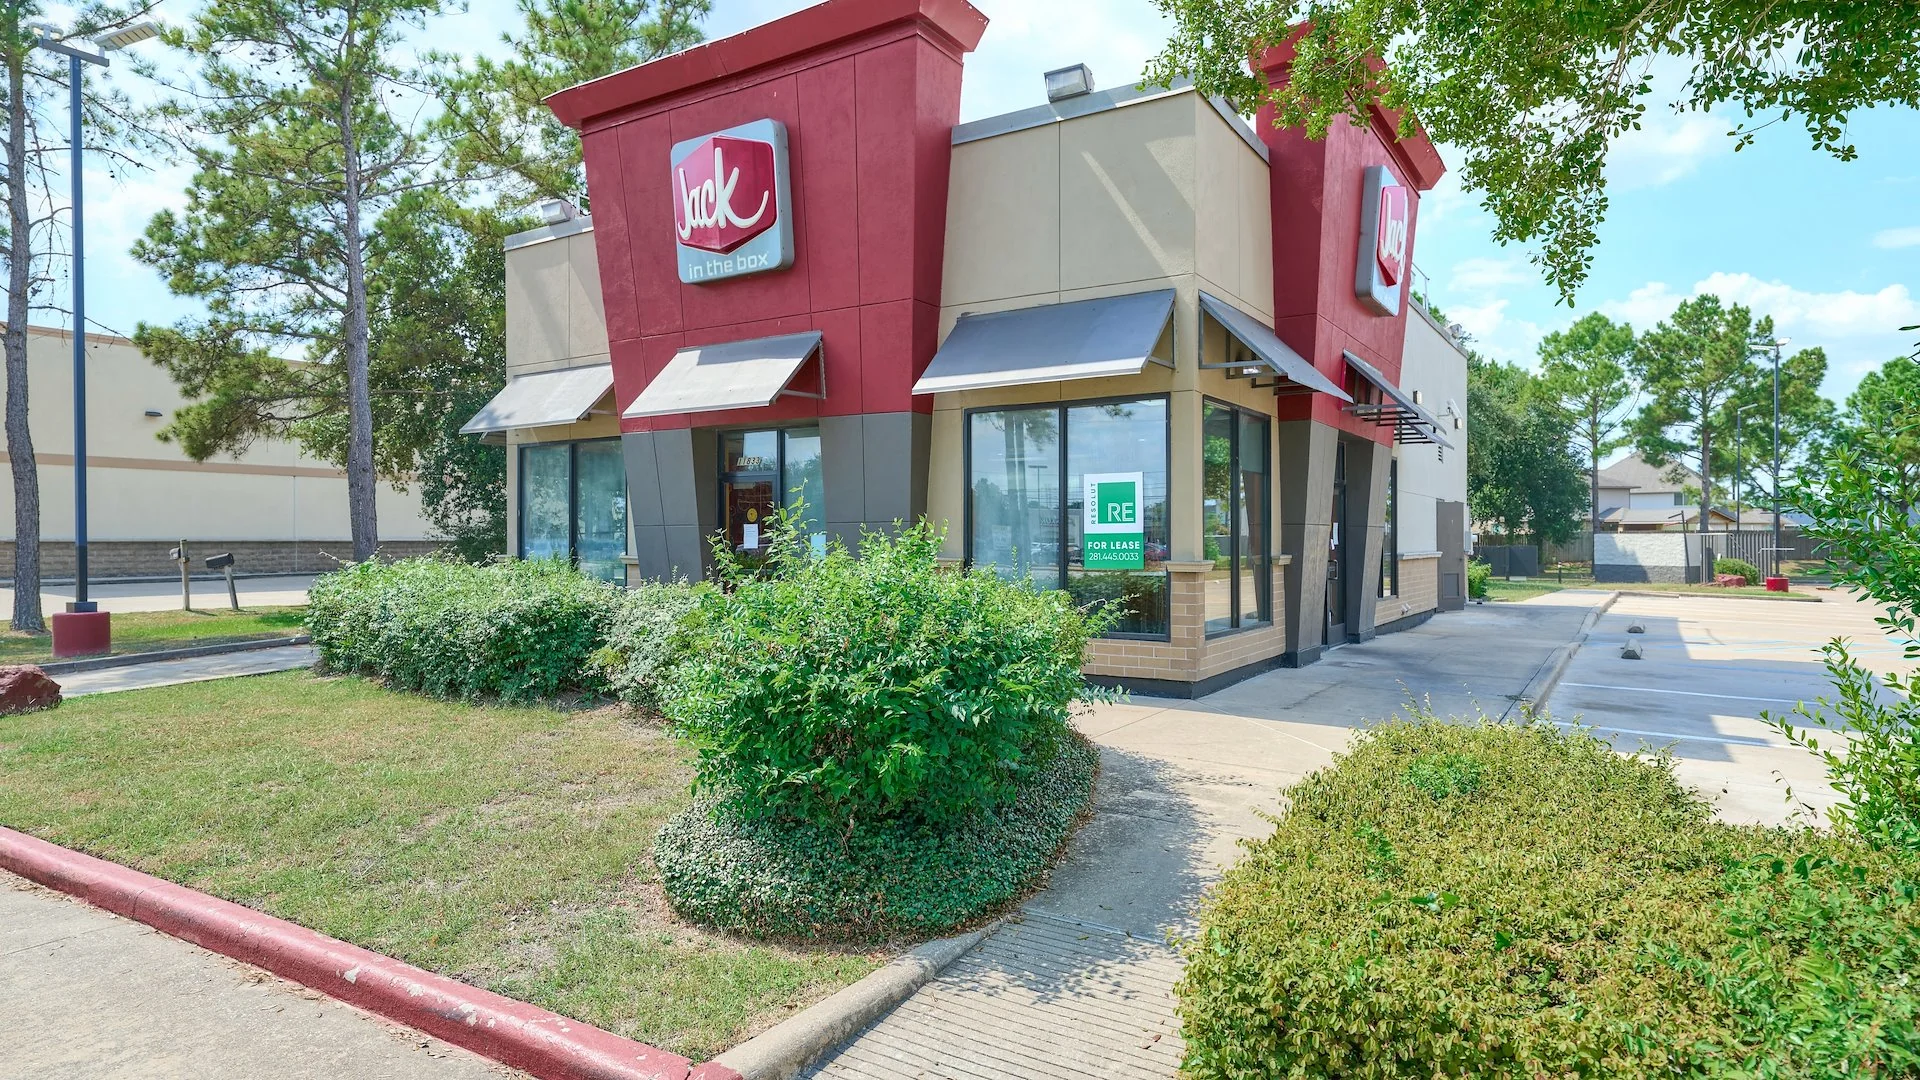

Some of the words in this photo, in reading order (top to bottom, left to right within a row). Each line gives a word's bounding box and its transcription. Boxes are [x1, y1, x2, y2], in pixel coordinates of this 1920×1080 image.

[678, 147, 769, 240] Jack
[688, 263, 704, 280] in
[706, 259, 733, 276] the
[736, 253, 769, 271] box
[1107, 502, 1134, 522] RE
[1087, 541, 1107, 550] FOR
[1110, 541, 1140, 550] LEASE
[1089, 552, 1139, 561] 281.445.0033
